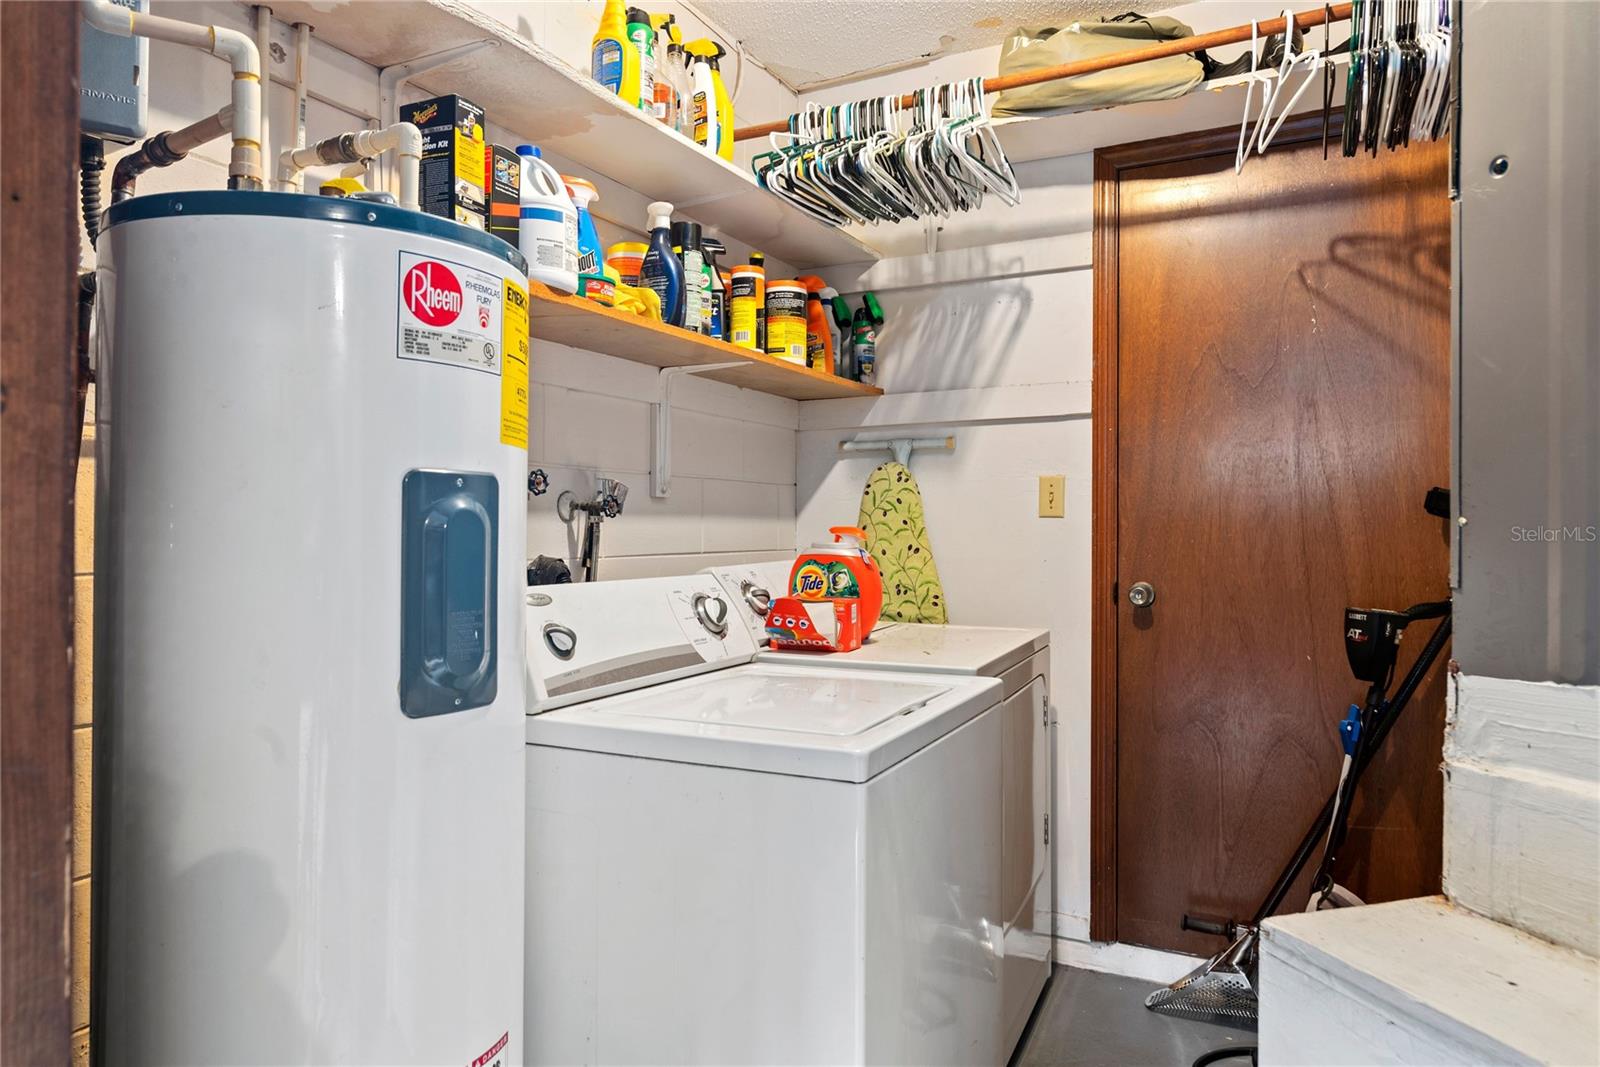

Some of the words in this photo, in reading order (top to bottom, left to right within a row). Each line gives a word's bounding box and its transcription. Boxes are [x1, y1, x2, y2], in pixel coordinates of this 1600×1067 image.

[411, 263, 460, 317] Rheem
[476, 295, 492, 306] FURY
[800, 575, 824, 593] Tide
[1347, 628, 1362, 639] AT
